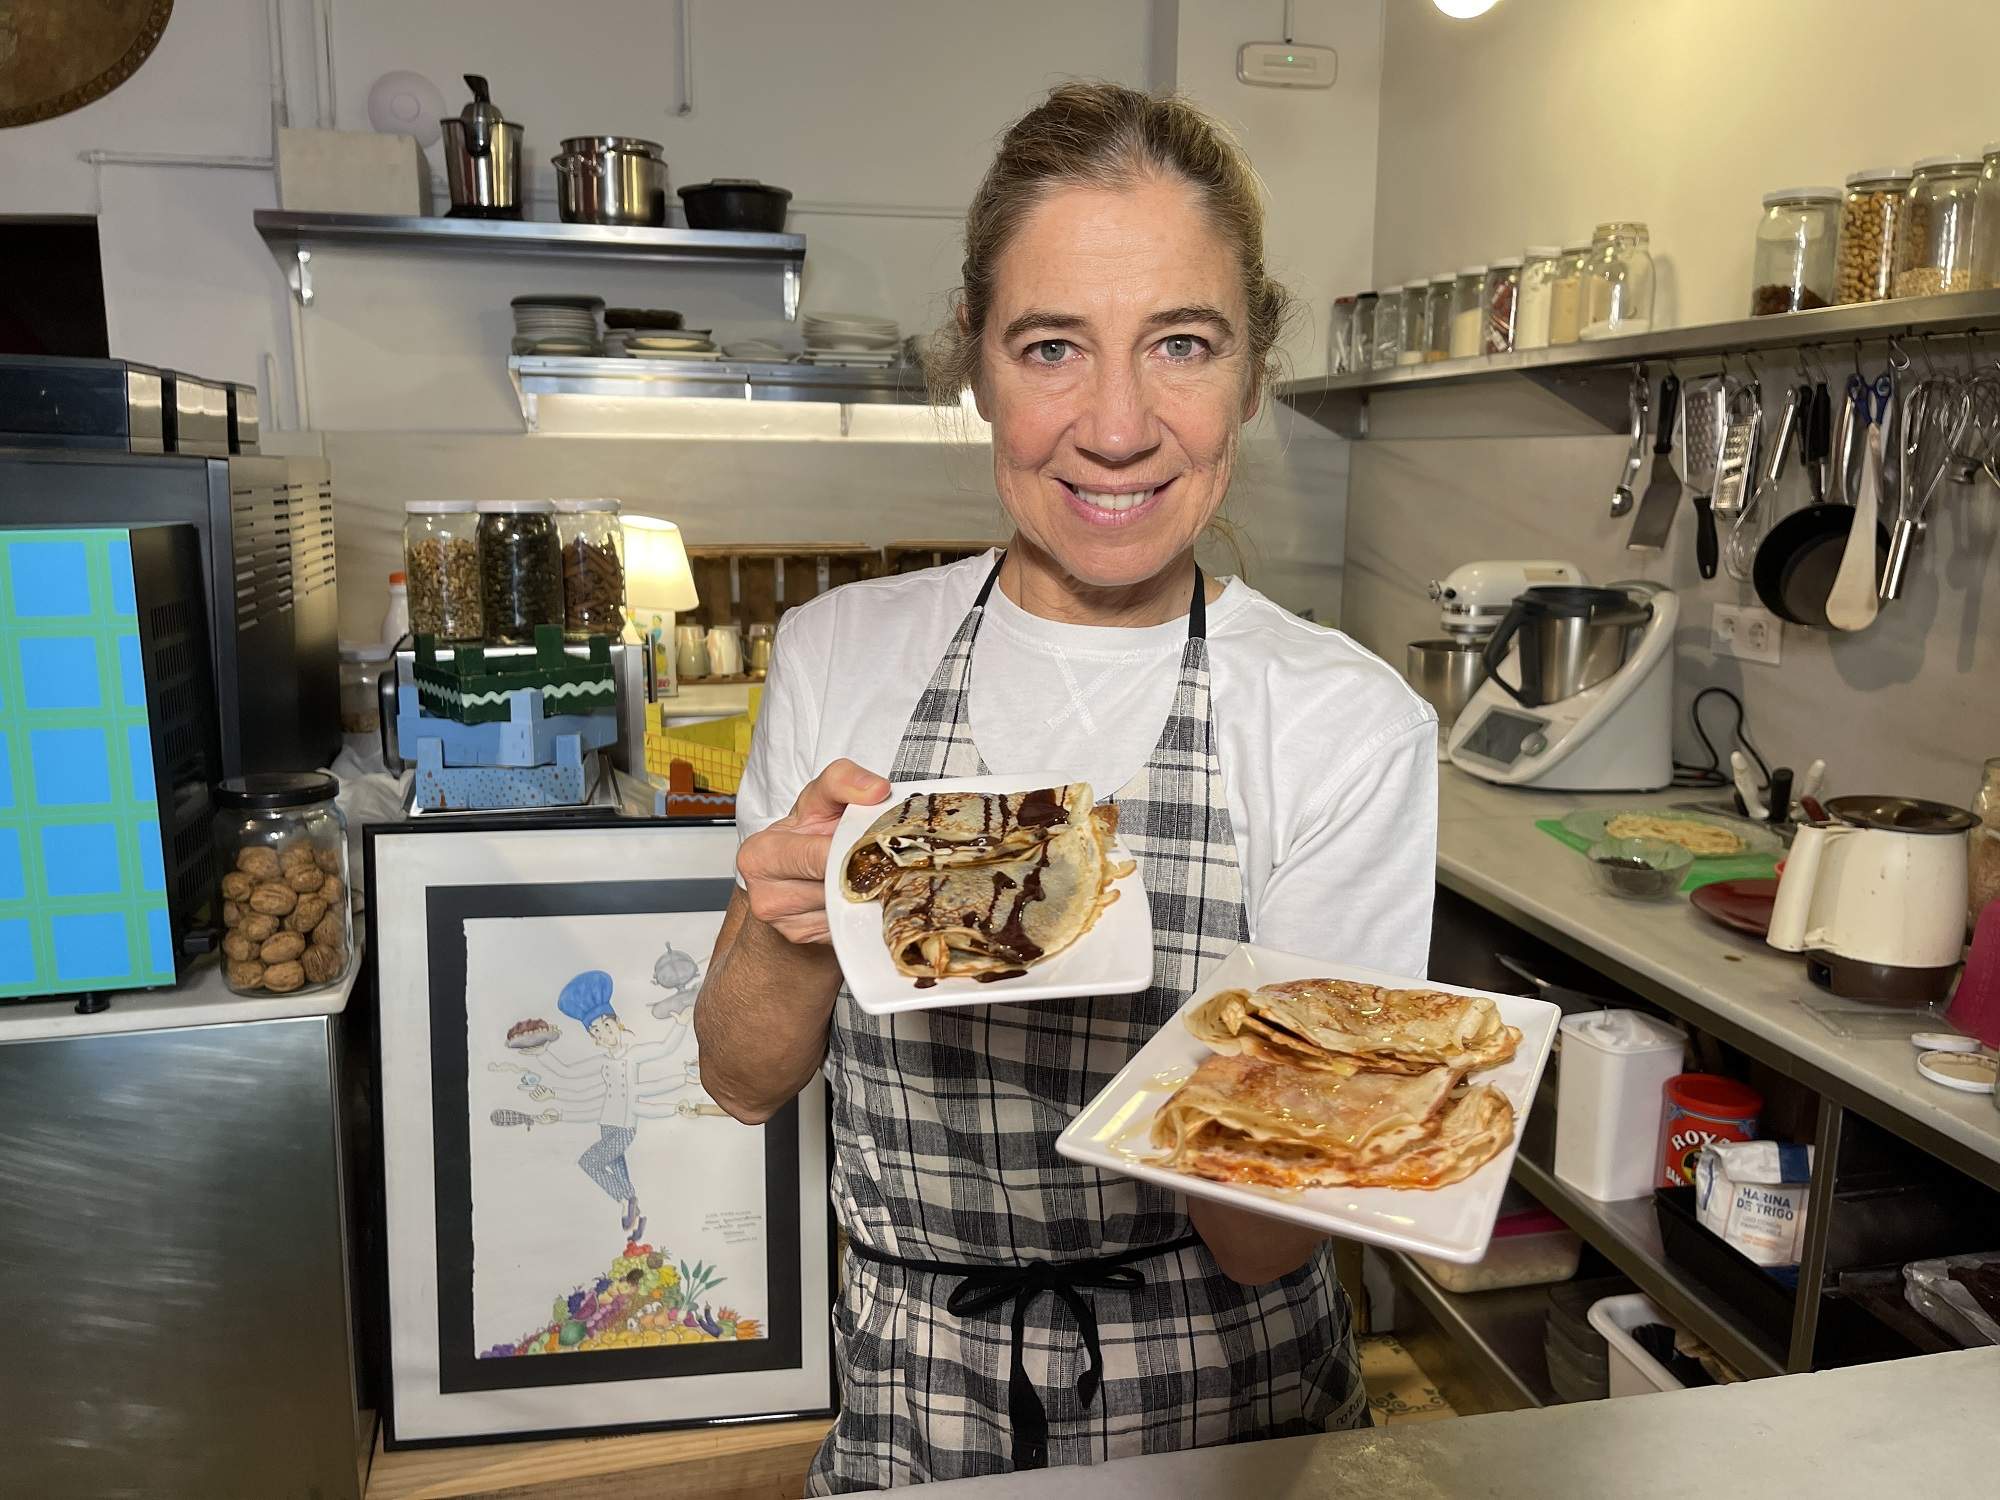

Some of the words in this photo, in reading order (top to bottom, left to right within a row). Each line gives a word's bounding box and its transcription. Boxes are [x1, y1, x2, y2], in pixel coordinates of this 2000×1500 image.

[1743, 1187, 1791, 1209] HARINA
[1737, 1198, 1752, 1212] DE
[1756, 1203, 1794, 1221] TRIGO
